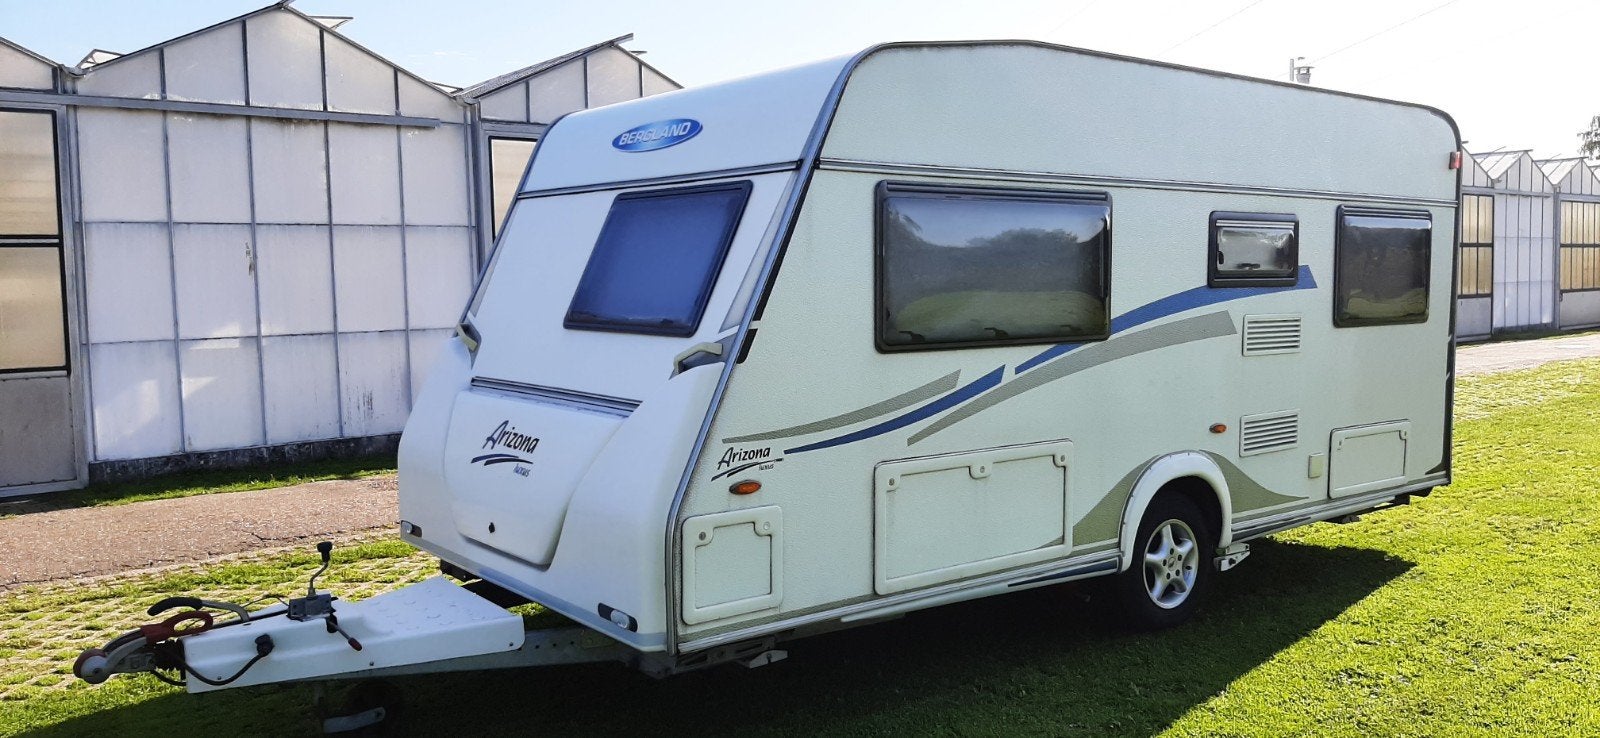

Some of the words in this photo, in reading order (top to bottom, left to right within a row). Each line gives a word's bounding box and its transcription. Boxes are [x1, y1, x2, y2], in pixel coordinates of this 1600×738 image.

[619, 122, 691, 145] BERGLAND
[482, 420, 540, 454] Arizona
[717, 447, 770, 470] Arizona
